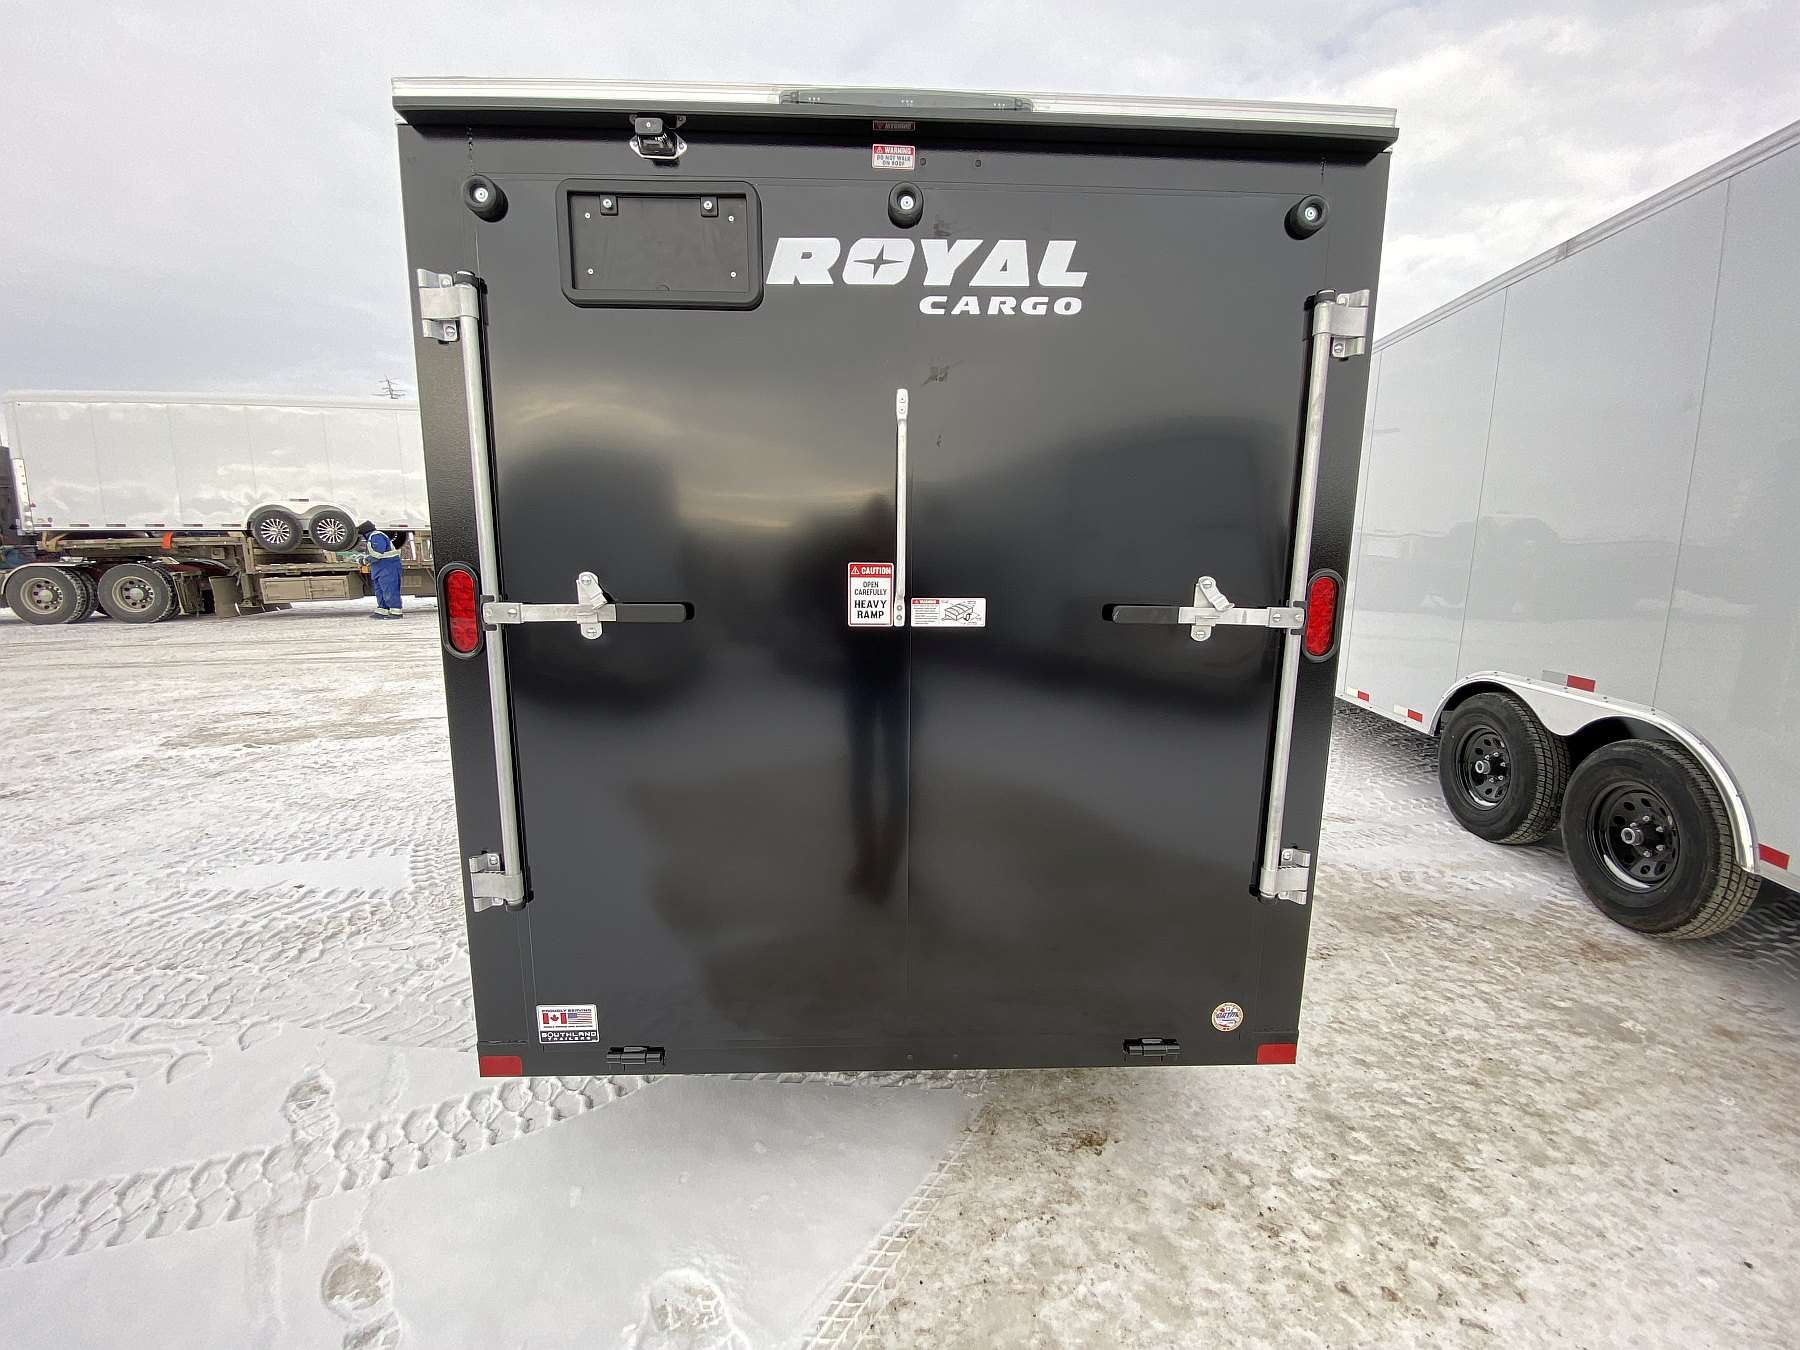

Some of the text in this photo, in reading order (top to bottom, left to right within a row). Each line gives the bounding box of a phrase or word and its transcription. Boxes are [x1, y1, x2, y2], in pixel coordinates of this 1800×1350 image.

[884, 147, 912, 155] WARNING
[765, 237, 1088, 288] ROYAL
[919, 295, 1082, 316] CARGO
[861, 566, 892, 575] CAUTION
[854, 588, 887, 596] CAREFULLY
[854, 600, 887, 609] HEAVY
[857, 610, 885, 619] RAMP
